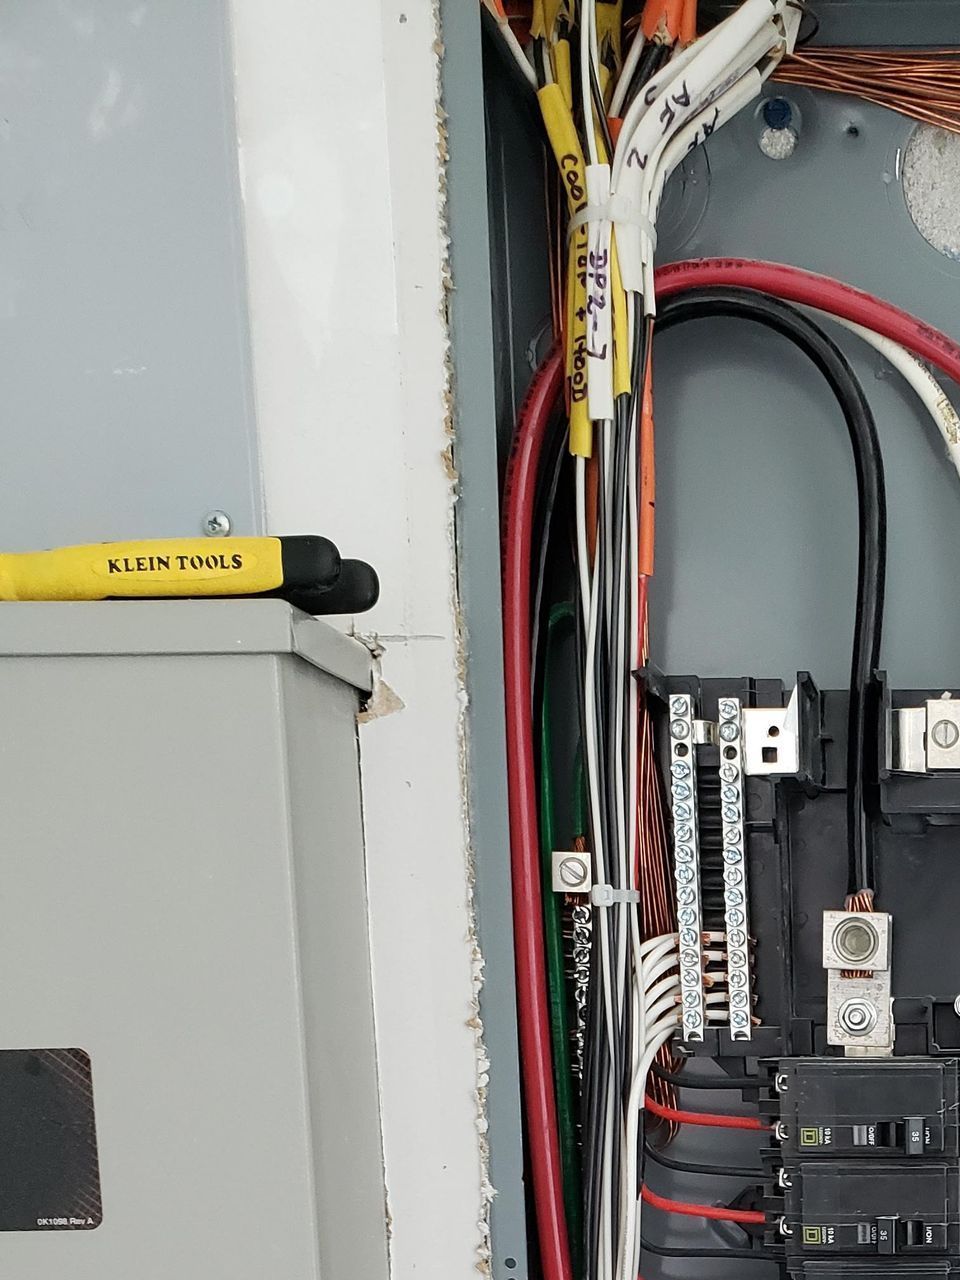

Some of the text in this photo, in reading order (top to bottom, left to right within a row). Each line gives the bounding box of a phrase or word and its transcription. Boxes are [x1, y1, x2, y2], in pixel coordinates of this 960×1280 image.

[108, 553, 243, 574] KLEIN TOOLS
[912, 1131, 920, 1142] 35
[880, 1230, 888, 1241] 35
